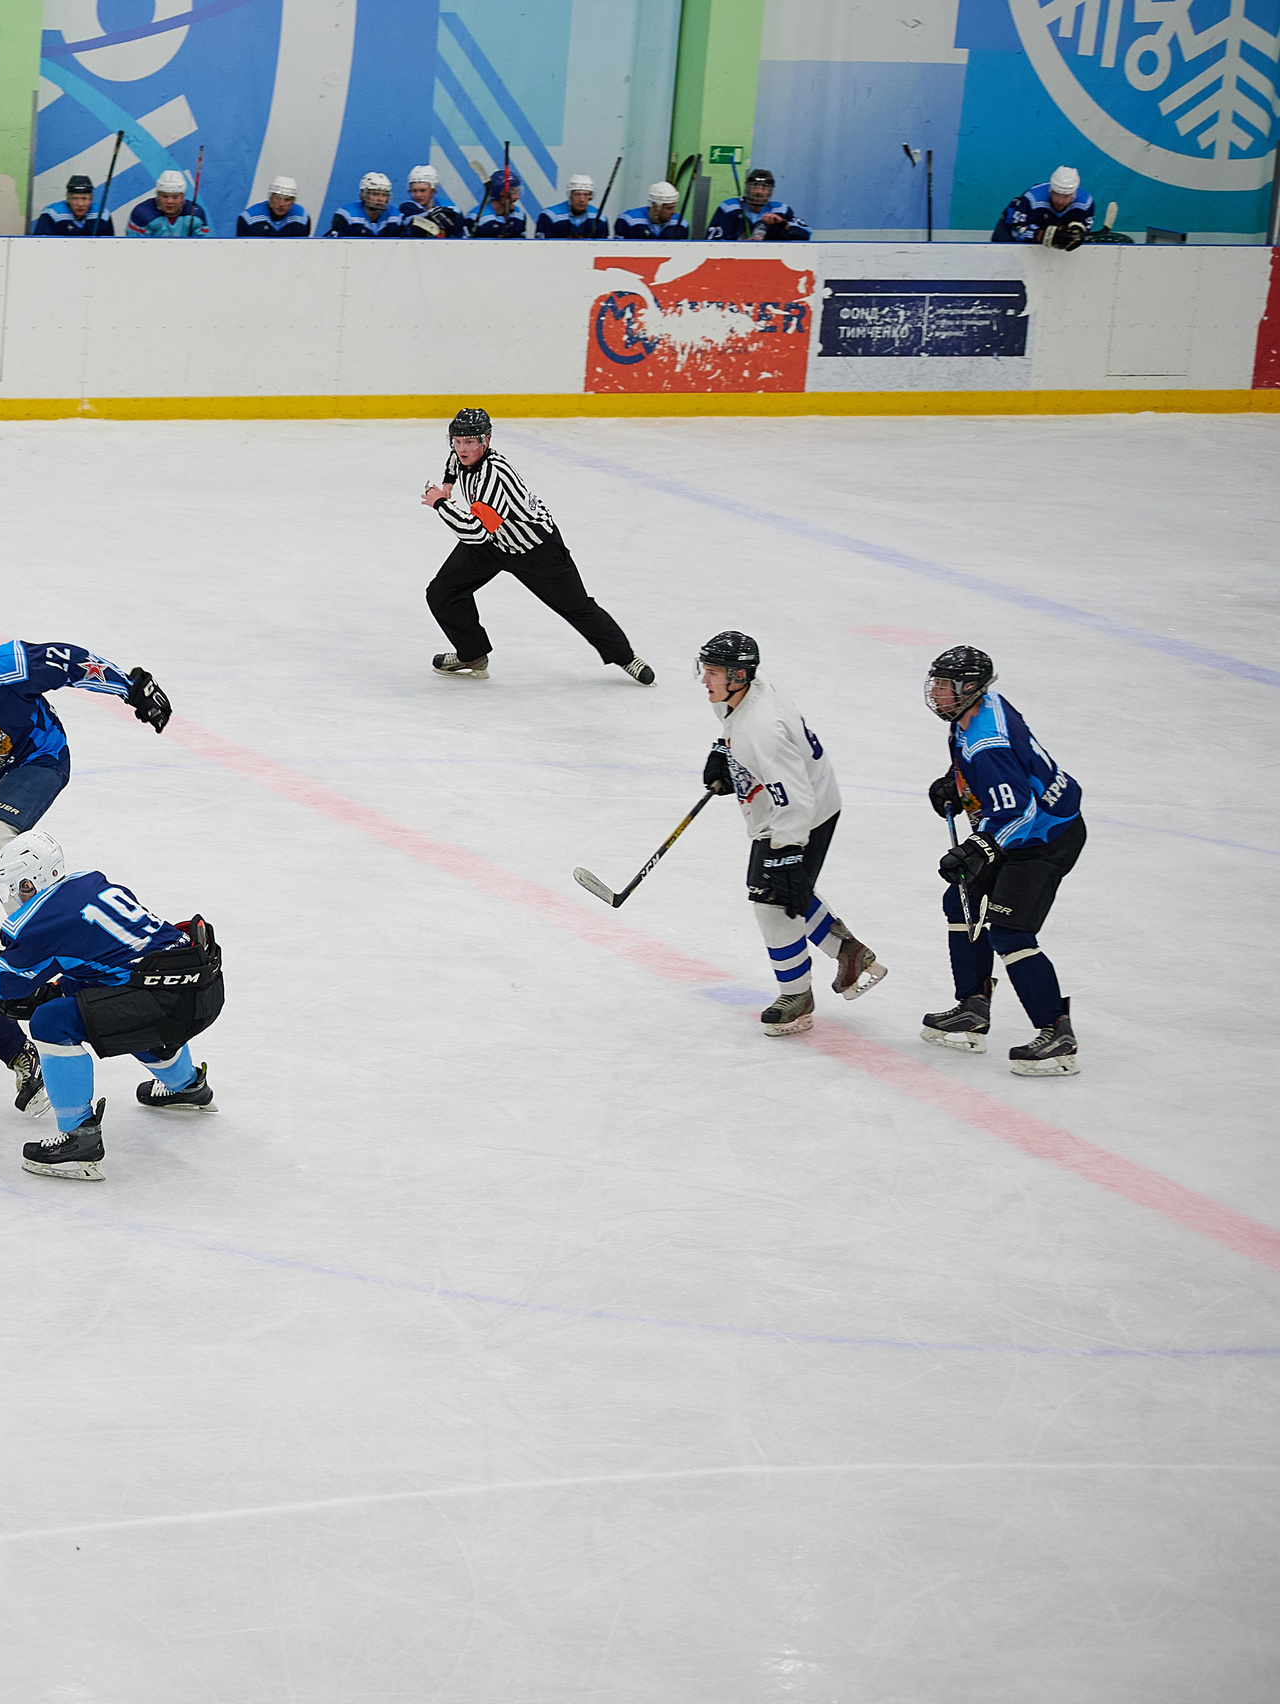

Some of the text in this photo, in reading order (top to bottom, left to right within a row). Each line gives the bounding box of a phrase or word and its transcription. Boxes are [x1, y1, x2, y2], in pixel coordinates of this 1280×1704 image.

[988, 783, 1017, 812] 18
[80, 887, 164, 953] 19
[143, 972, 201, 986] CCM
